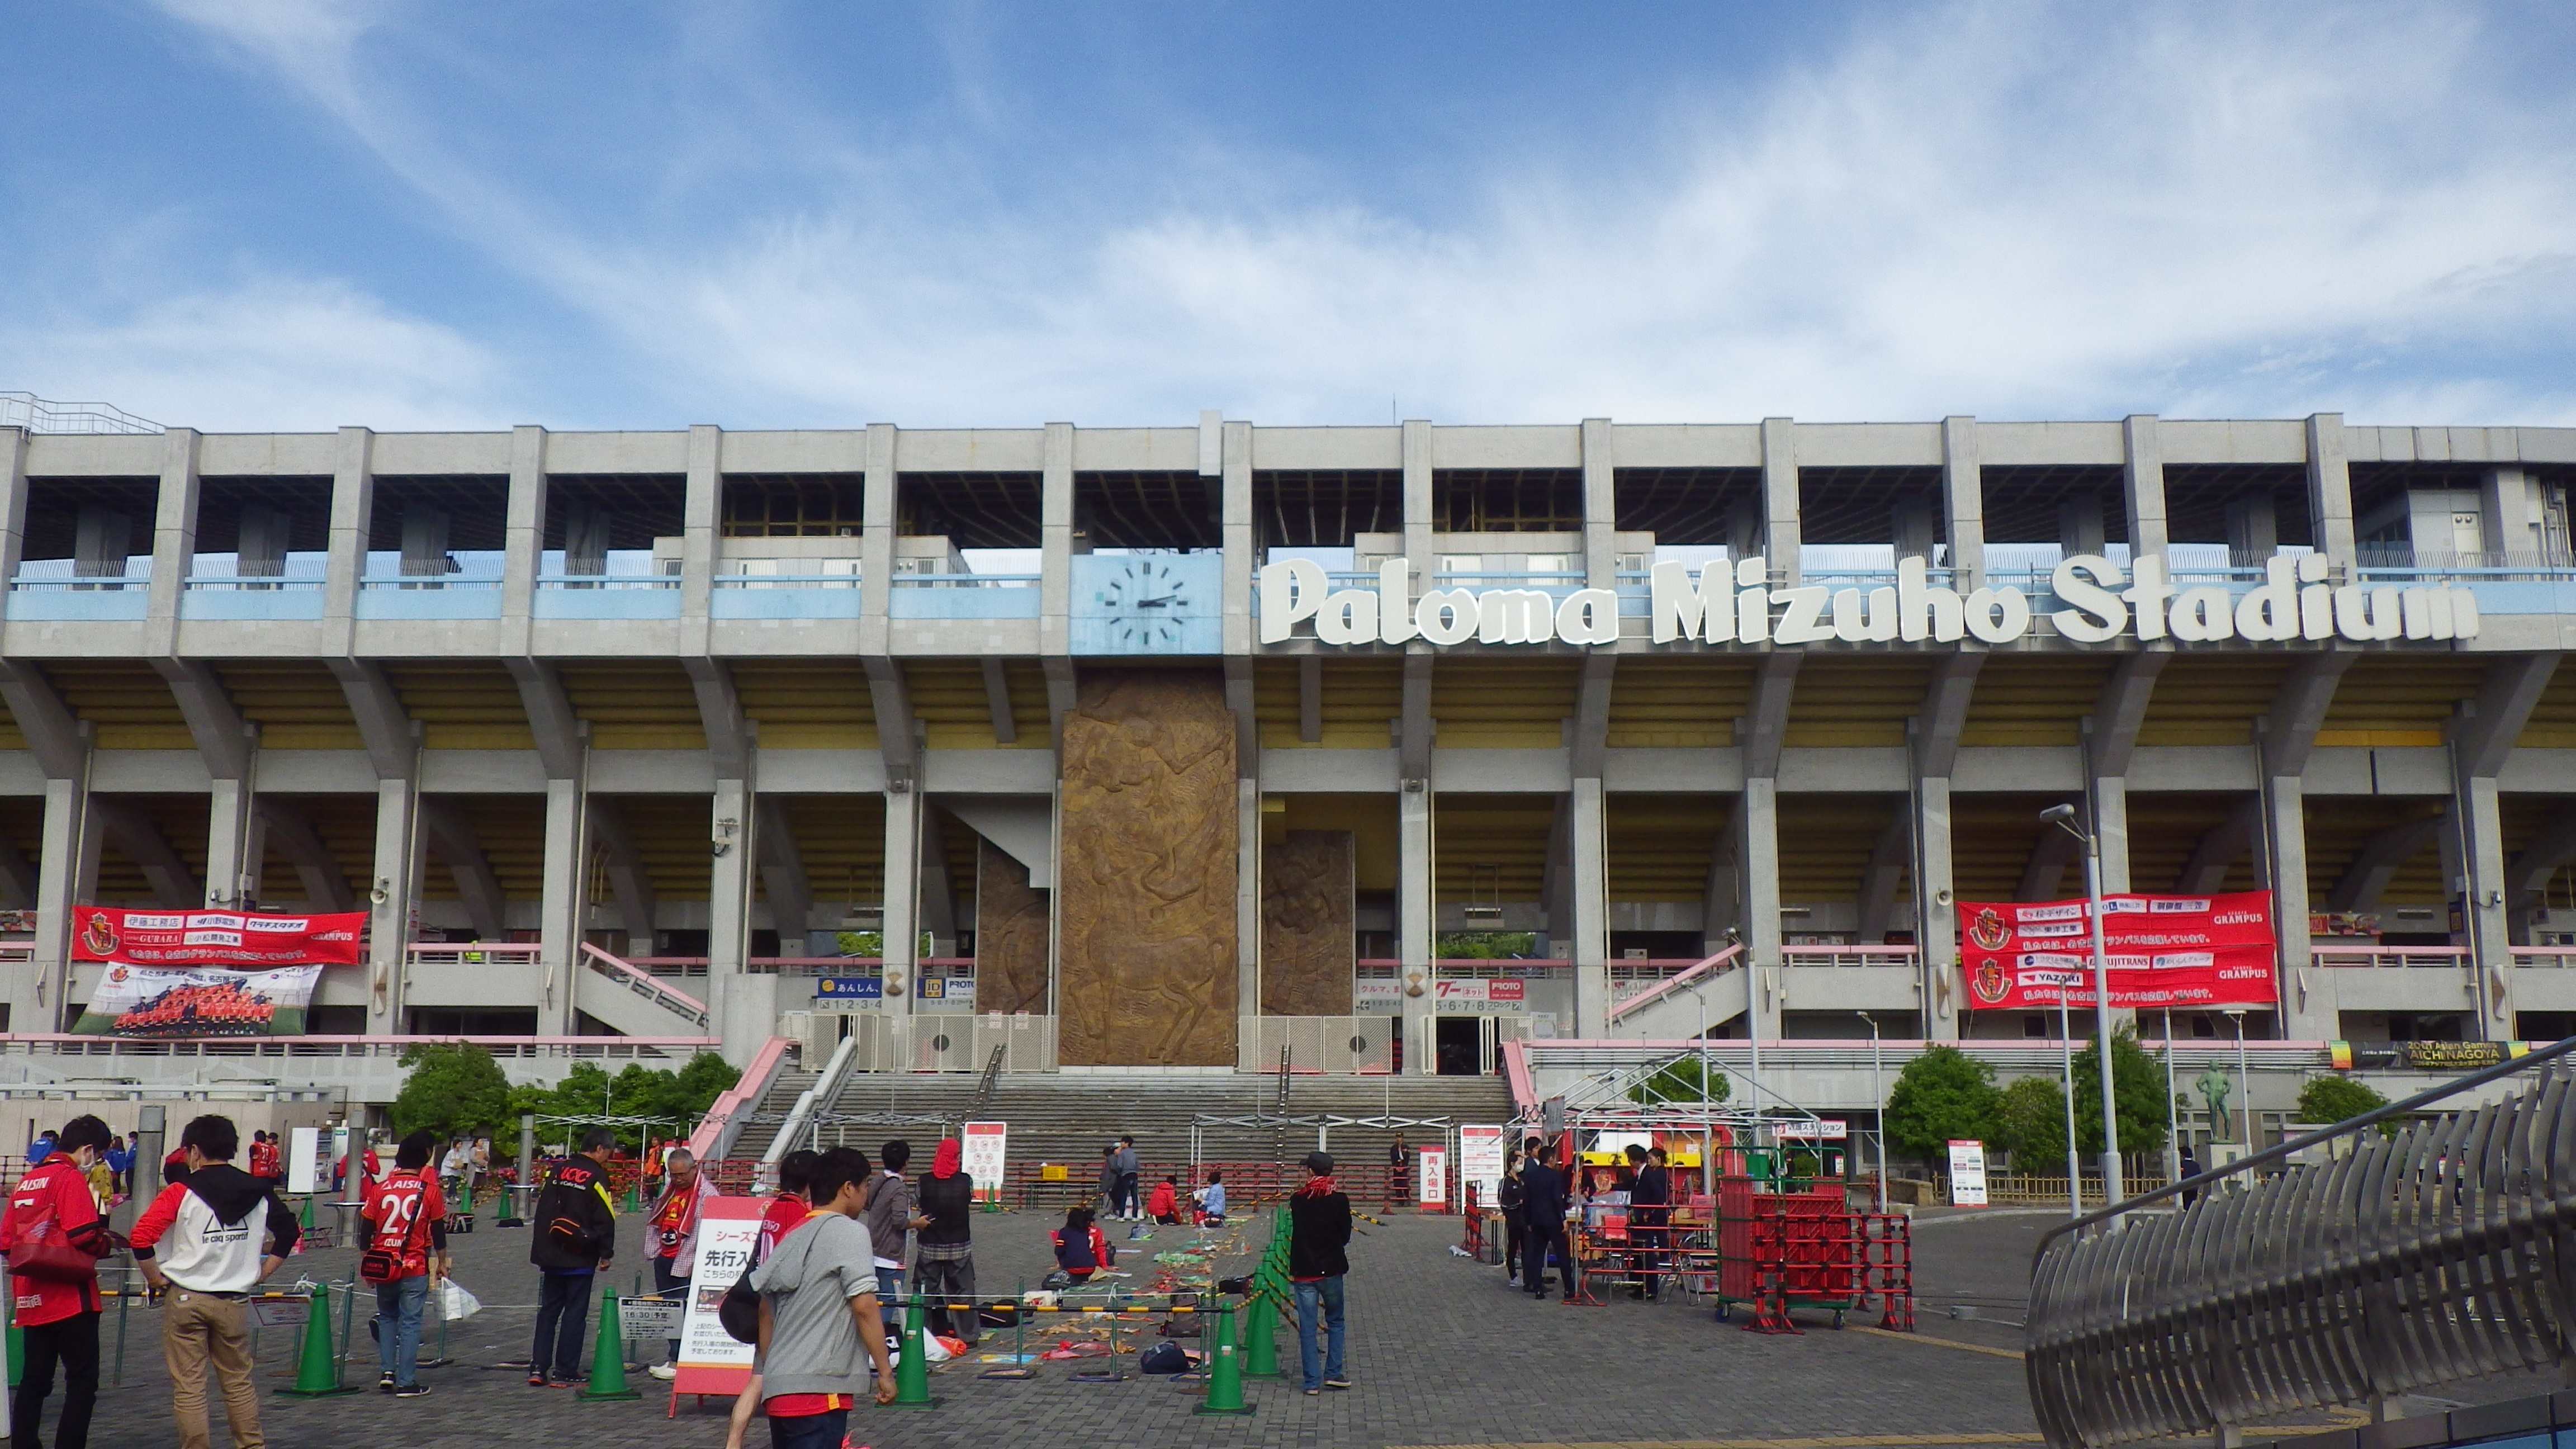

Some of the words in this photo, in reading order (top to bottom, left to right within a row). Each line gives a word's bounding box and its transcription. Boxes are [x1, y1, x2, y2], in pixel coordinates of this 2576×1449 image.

[1260, 558, 1619, 645] Paloma
[1651, 556, 2030, 645] Mizuho
[2052, 552, 2479, 643] Stadium
[129, 917, 179, 927] 伊藤工務店
[2214, 913, 2263, 925] GRAMPUS
[2023, 933, 2210, 951] 私たちは、名古屋ランパスを応援しています。
[2104, 957, 2148, 967] UJITRANS
[2219, 968, 2268, 979] GRAMPUS
[837, 983, 879, 993] あんしん、
[1491, 982, 1521, 991] PROTO
[2446, 1049, 2500, 1060] NAGOYA
[1427, 1156, 1438, 1199] 再入場口
[18, 1176, 50, 1191] AISIN
[381, 1194, 423, 1234] 29
[202, 1235, 209, 1244] le
